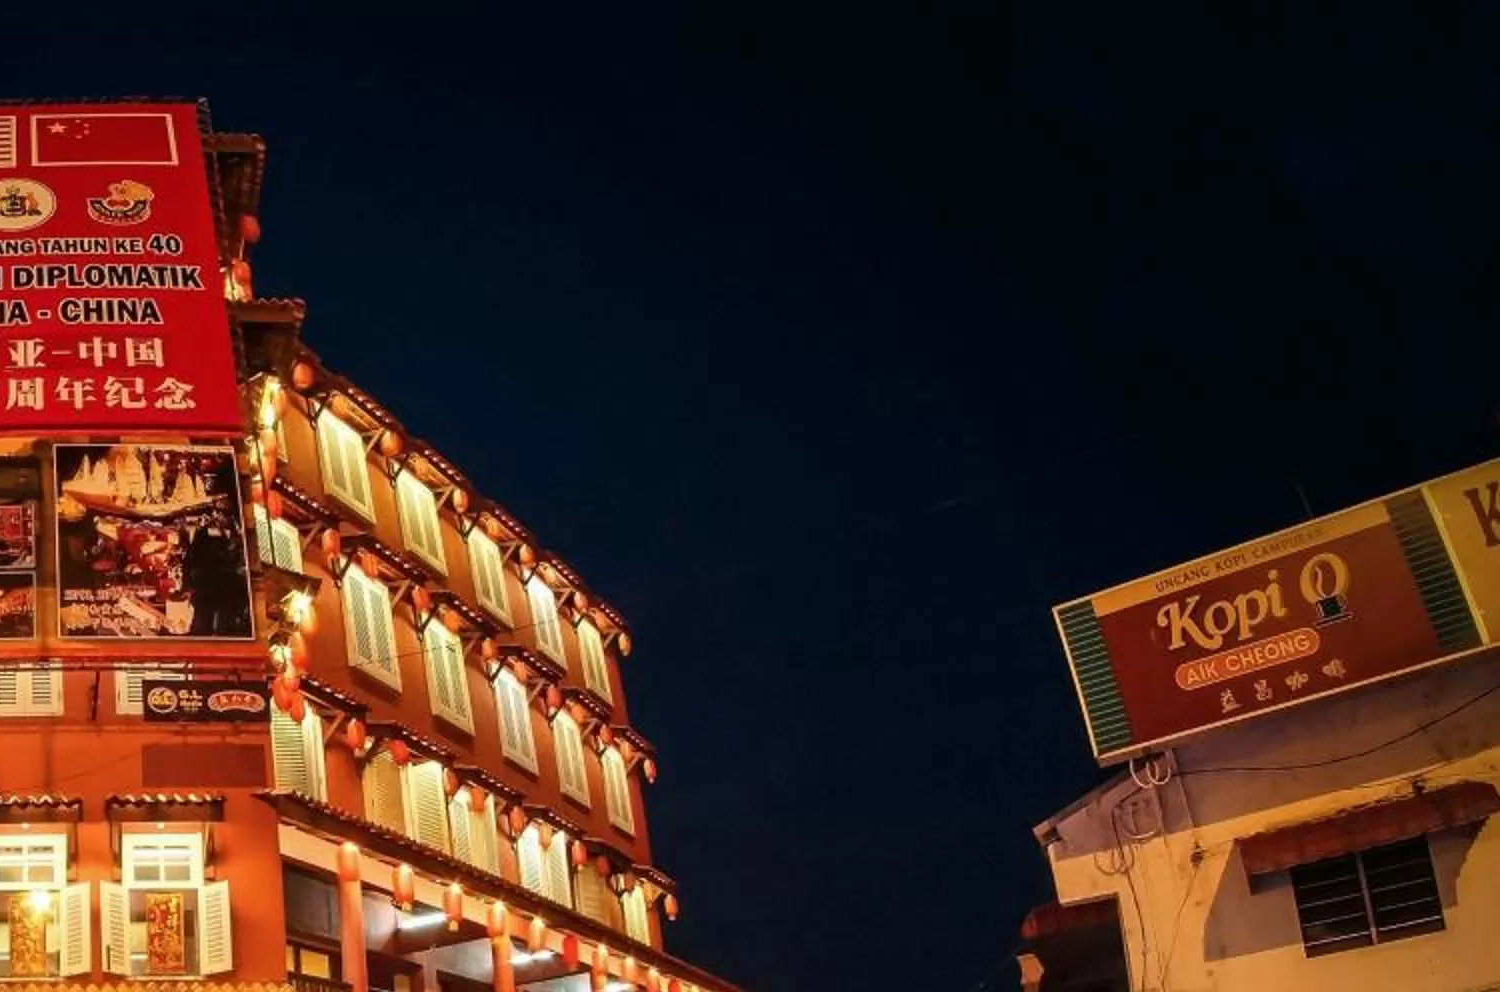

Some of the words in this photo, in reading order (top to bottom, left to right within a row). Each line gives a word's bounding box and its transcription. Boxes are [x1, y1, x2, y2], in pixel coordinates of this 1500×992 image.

[40, 237, 108, 256] TAHUN
[113, 236, 143, 255] KE
[147, 233, 183, 256] 40
[12, 263, 206, 292] DIPLOMATIK
[58, 297, 164, 325] CHINA
[1215, 553, 1246, 572] KOPI
[1156, 569, 1289, 651] Kopi
[1186, 660, 1220, 690] AIK
[1225, 634, 1310, 672] CHEONG
